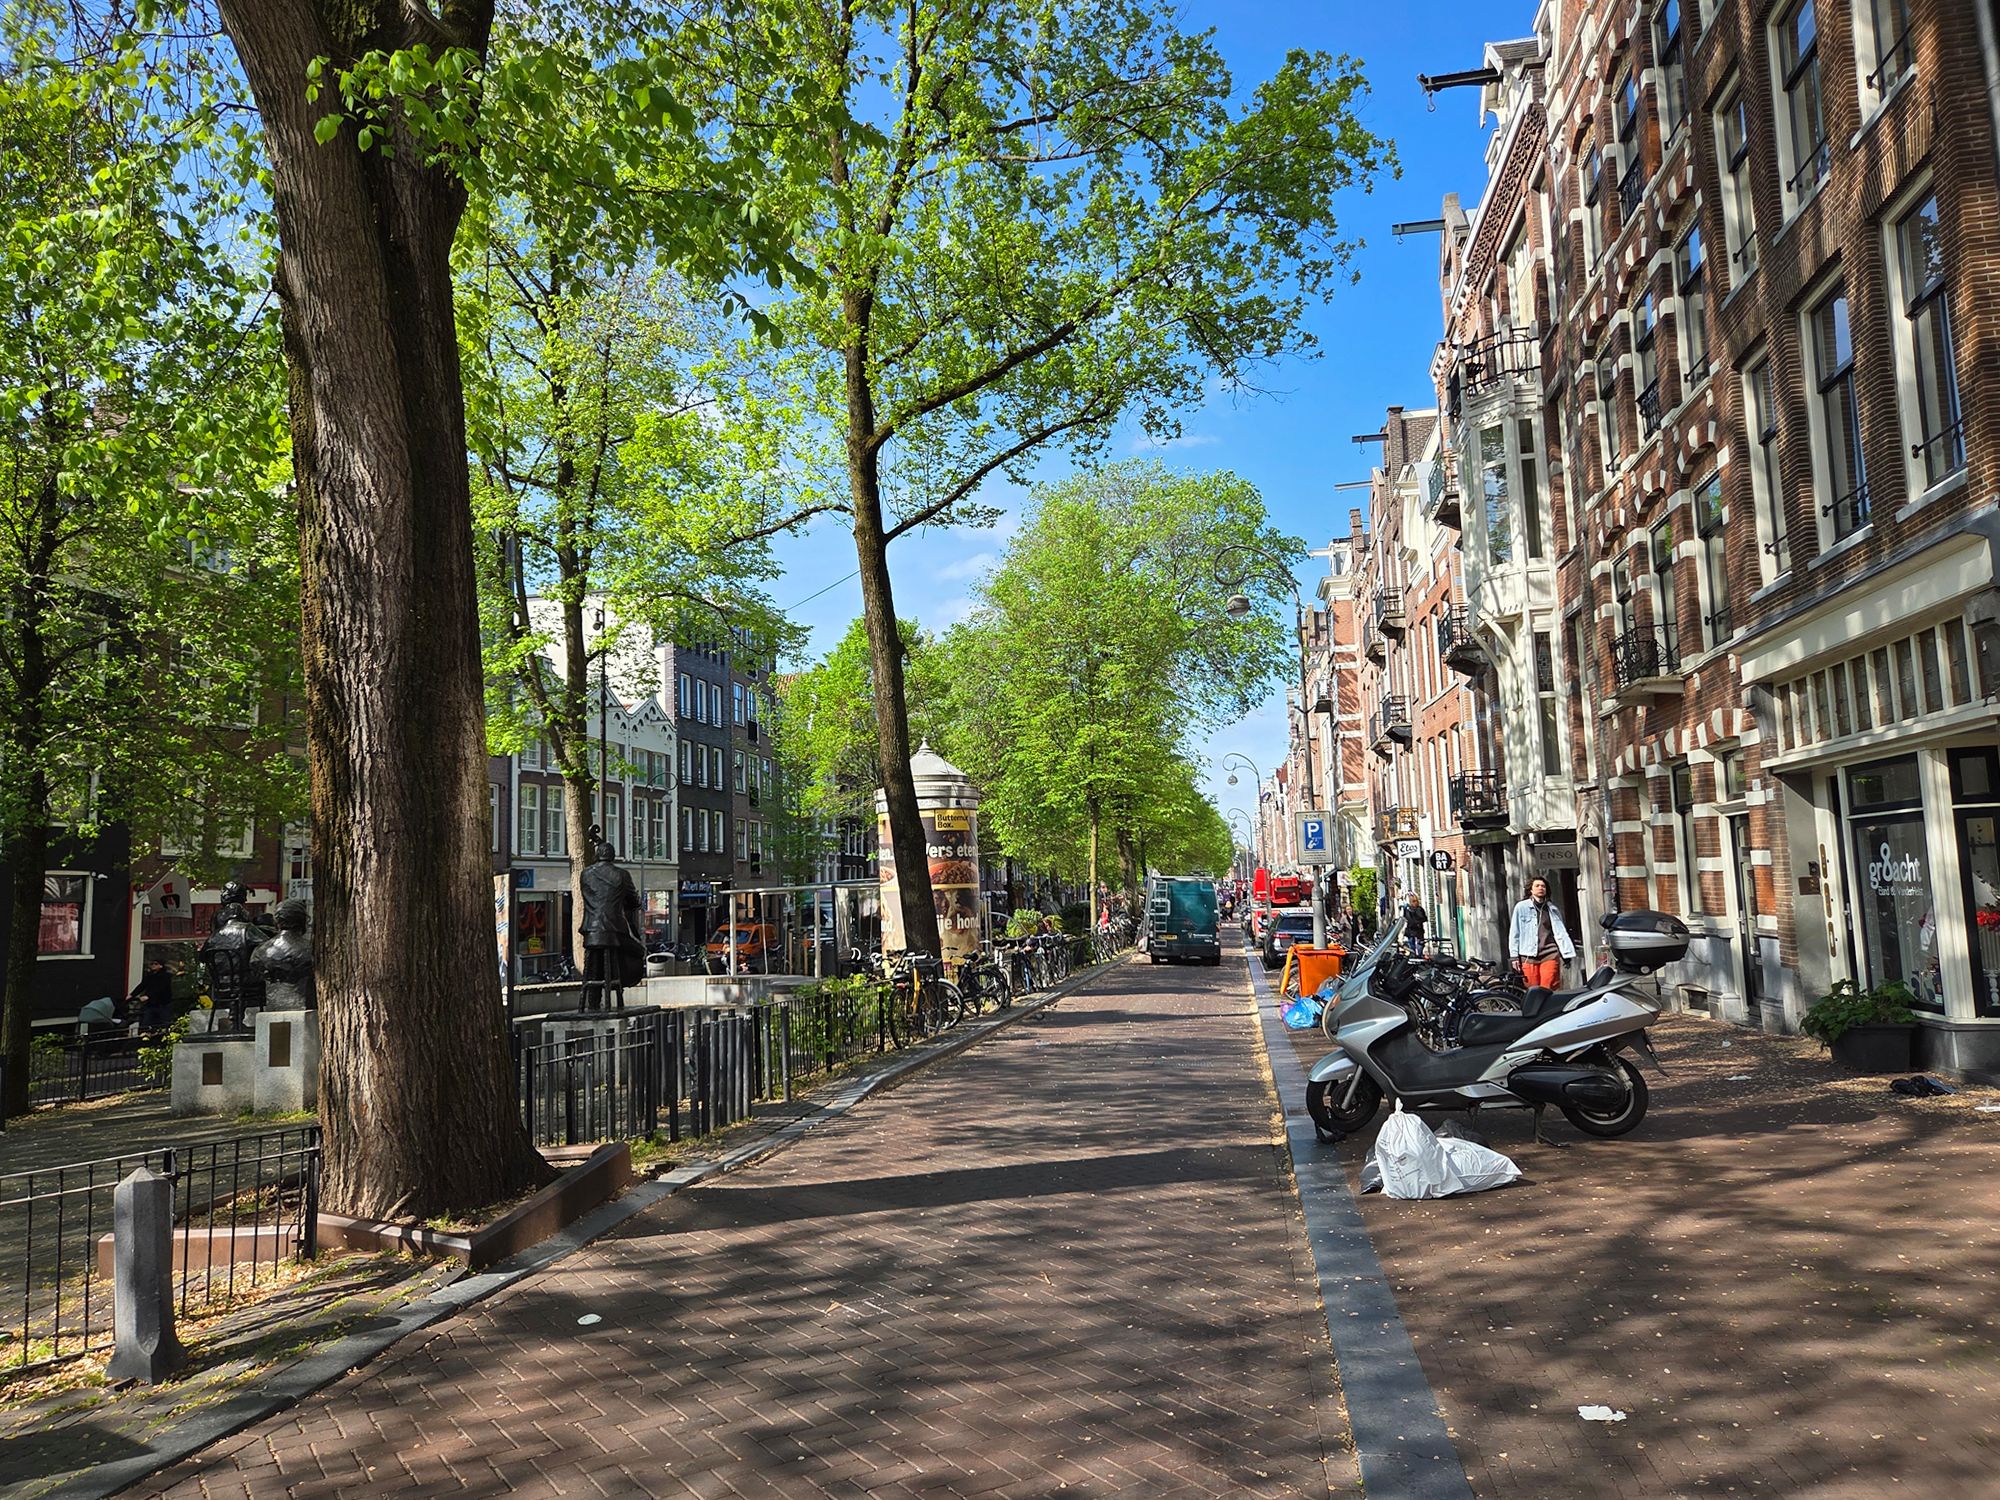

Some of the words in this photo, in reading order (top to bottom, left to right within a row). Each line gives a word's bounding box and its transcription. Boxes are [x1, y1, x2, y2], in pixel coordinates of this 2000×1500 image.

[937, 821, 954, 829] Box.
[1307, 822, 1320, 838] P
[1400, 842, 1418, 853] Etos
[1434, 852, 1448, 861] BA
[1436, 860, 1448, 870] RT
